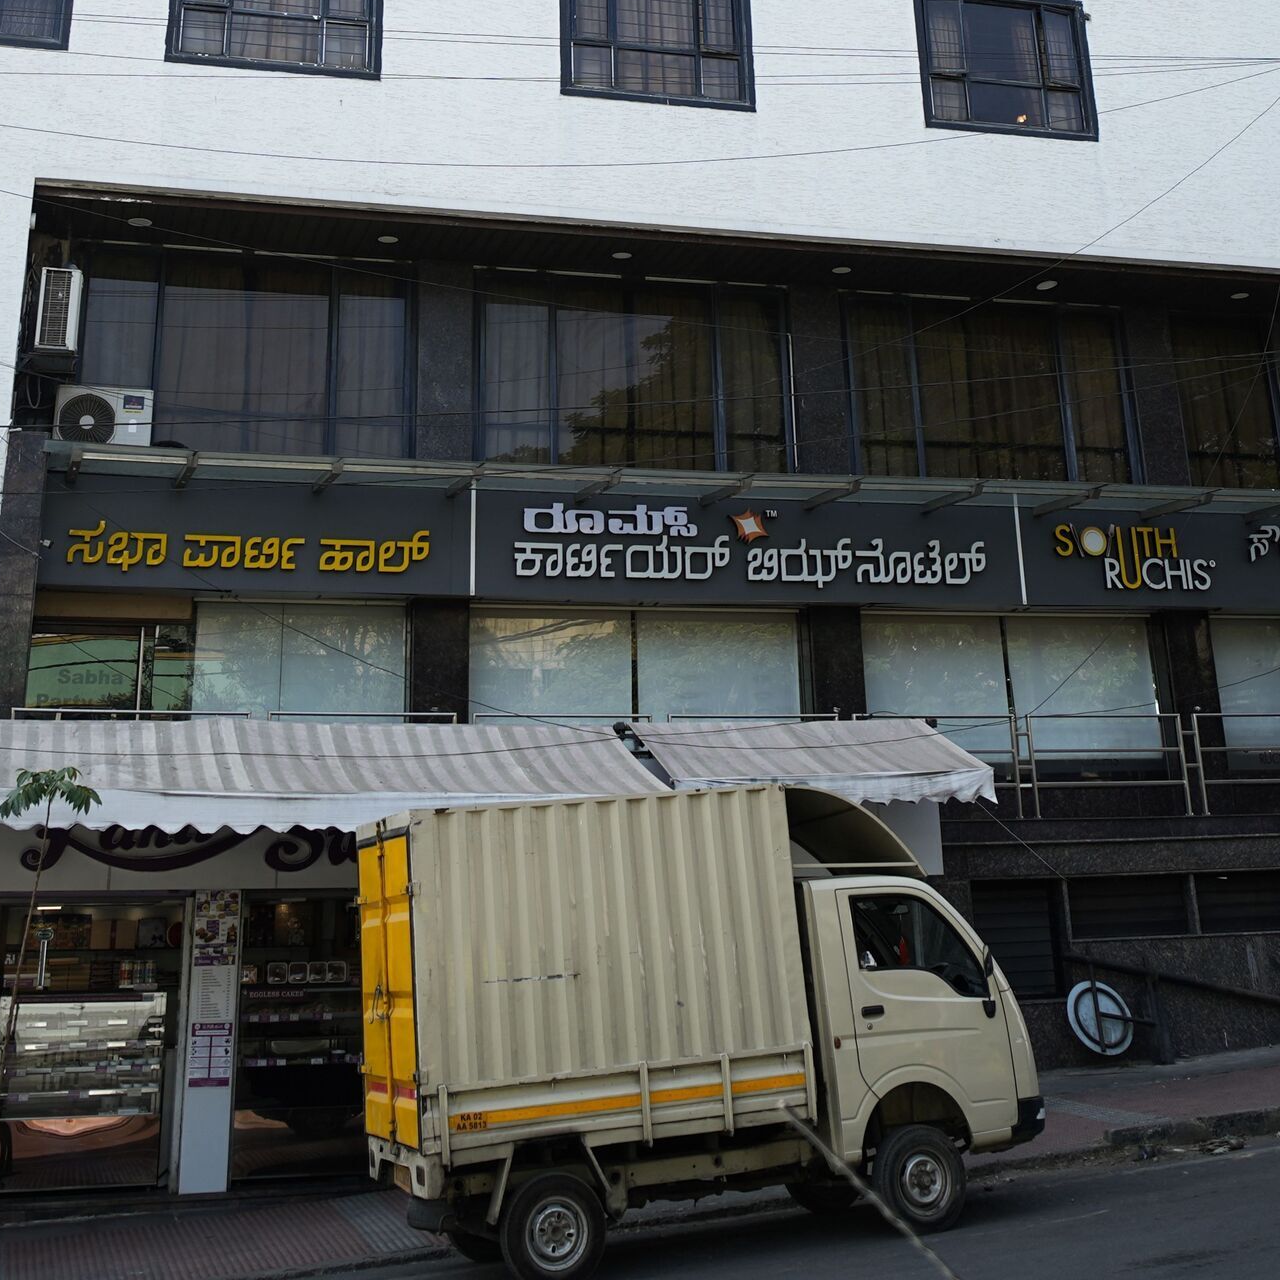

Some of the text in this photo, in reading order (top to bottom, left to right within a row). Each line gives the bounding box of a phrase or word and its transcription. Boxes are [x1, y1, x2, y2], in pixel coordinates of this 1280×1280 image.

[523, 502, 698, 537] ರೂಮ್ಸ್
[66, 519, 431, 574] ಸಭಾ ಪಾರ್ಟಿ ಹಾಲ್
[513, 535, 731, 580] ಕಾರ್ಟಿಯರ್
[1104, 556, 1213, 591] RUCHIS
[58, 669, 123, 684] Sabha
[249, 989, 304, 999] EGGLESS CAKES
[460, 1112, 482, 1122] KA 02
